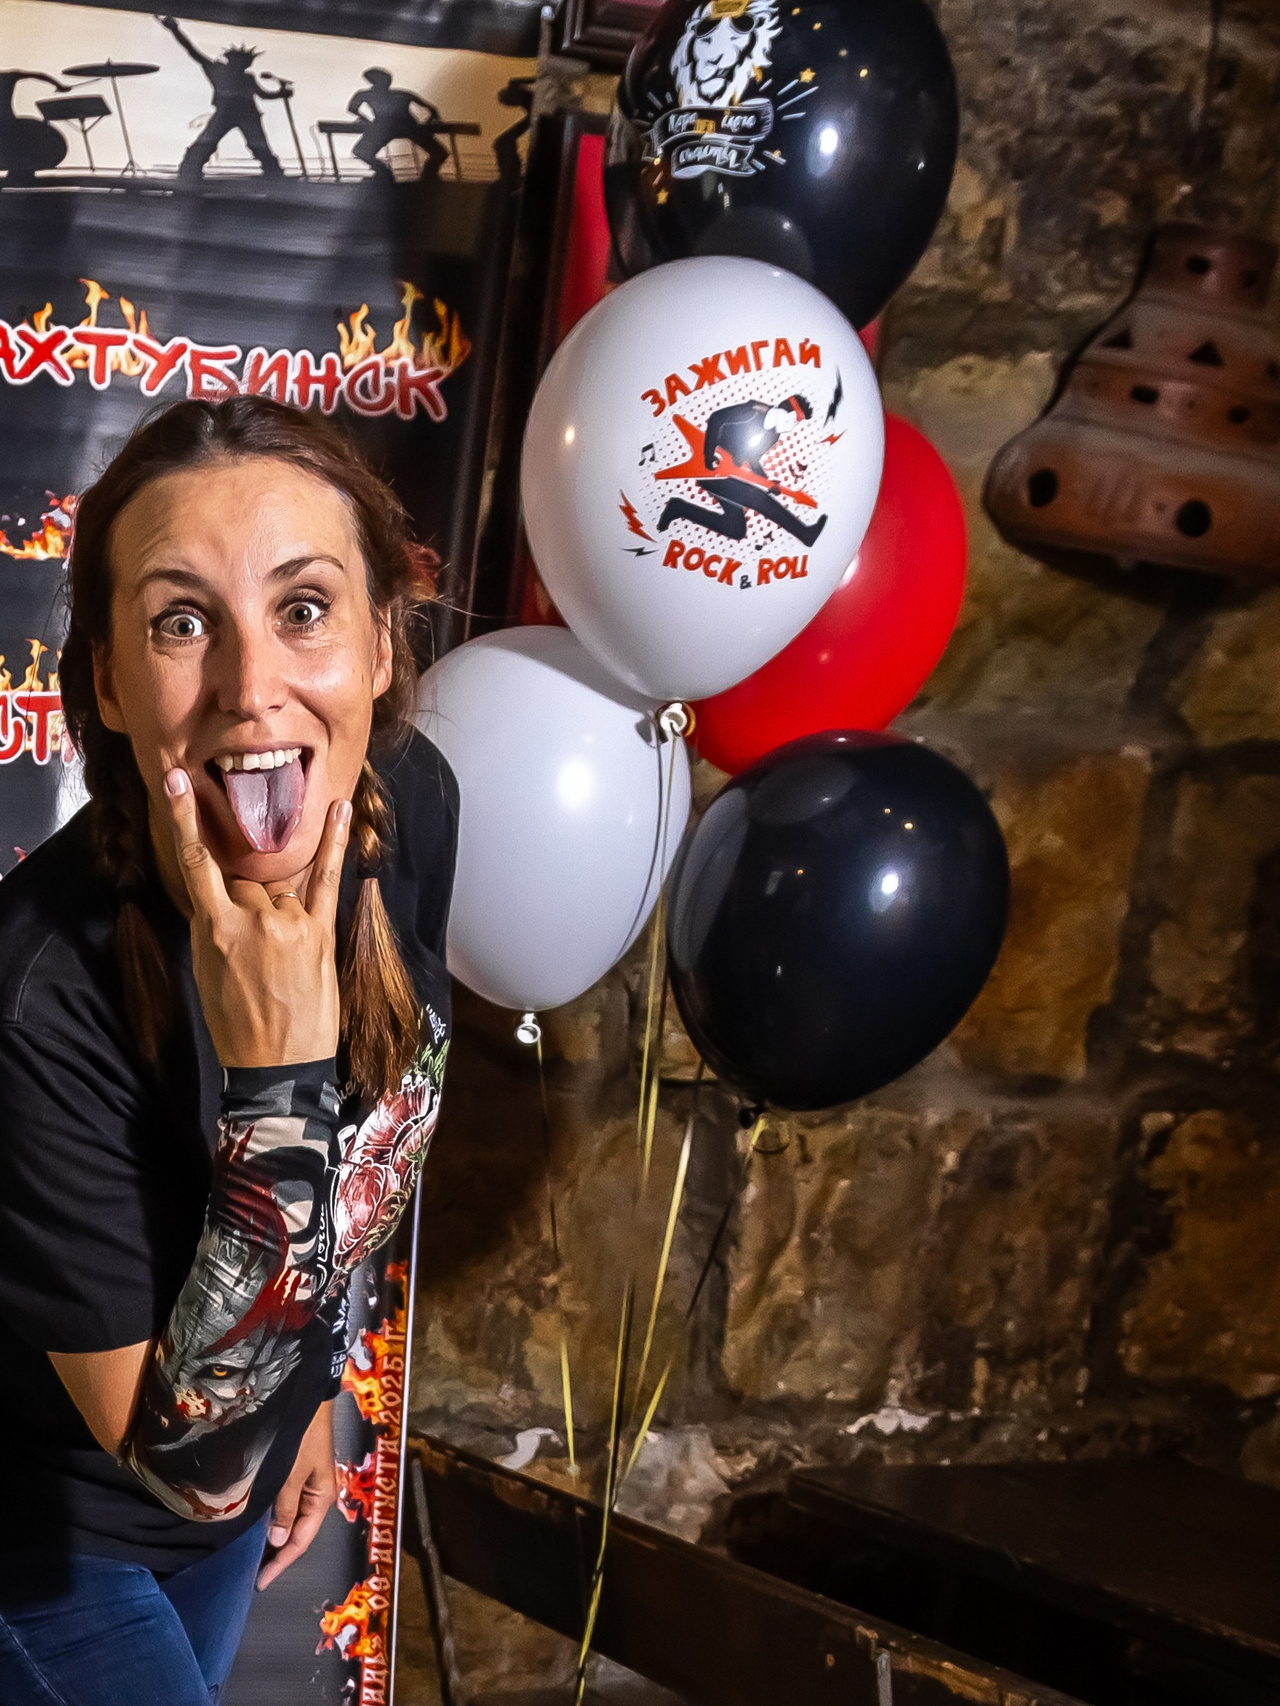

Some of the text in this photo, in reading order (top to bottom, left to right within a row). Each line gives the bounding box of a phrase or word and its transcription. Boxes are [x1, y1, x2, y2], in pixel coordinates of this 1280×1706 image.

[641, 338, 821, 418] ЗАЖИГАЙ
[662, 540, 809, 589] ROCK & ROLL
[379, 1355, 405, 1425] 2025
